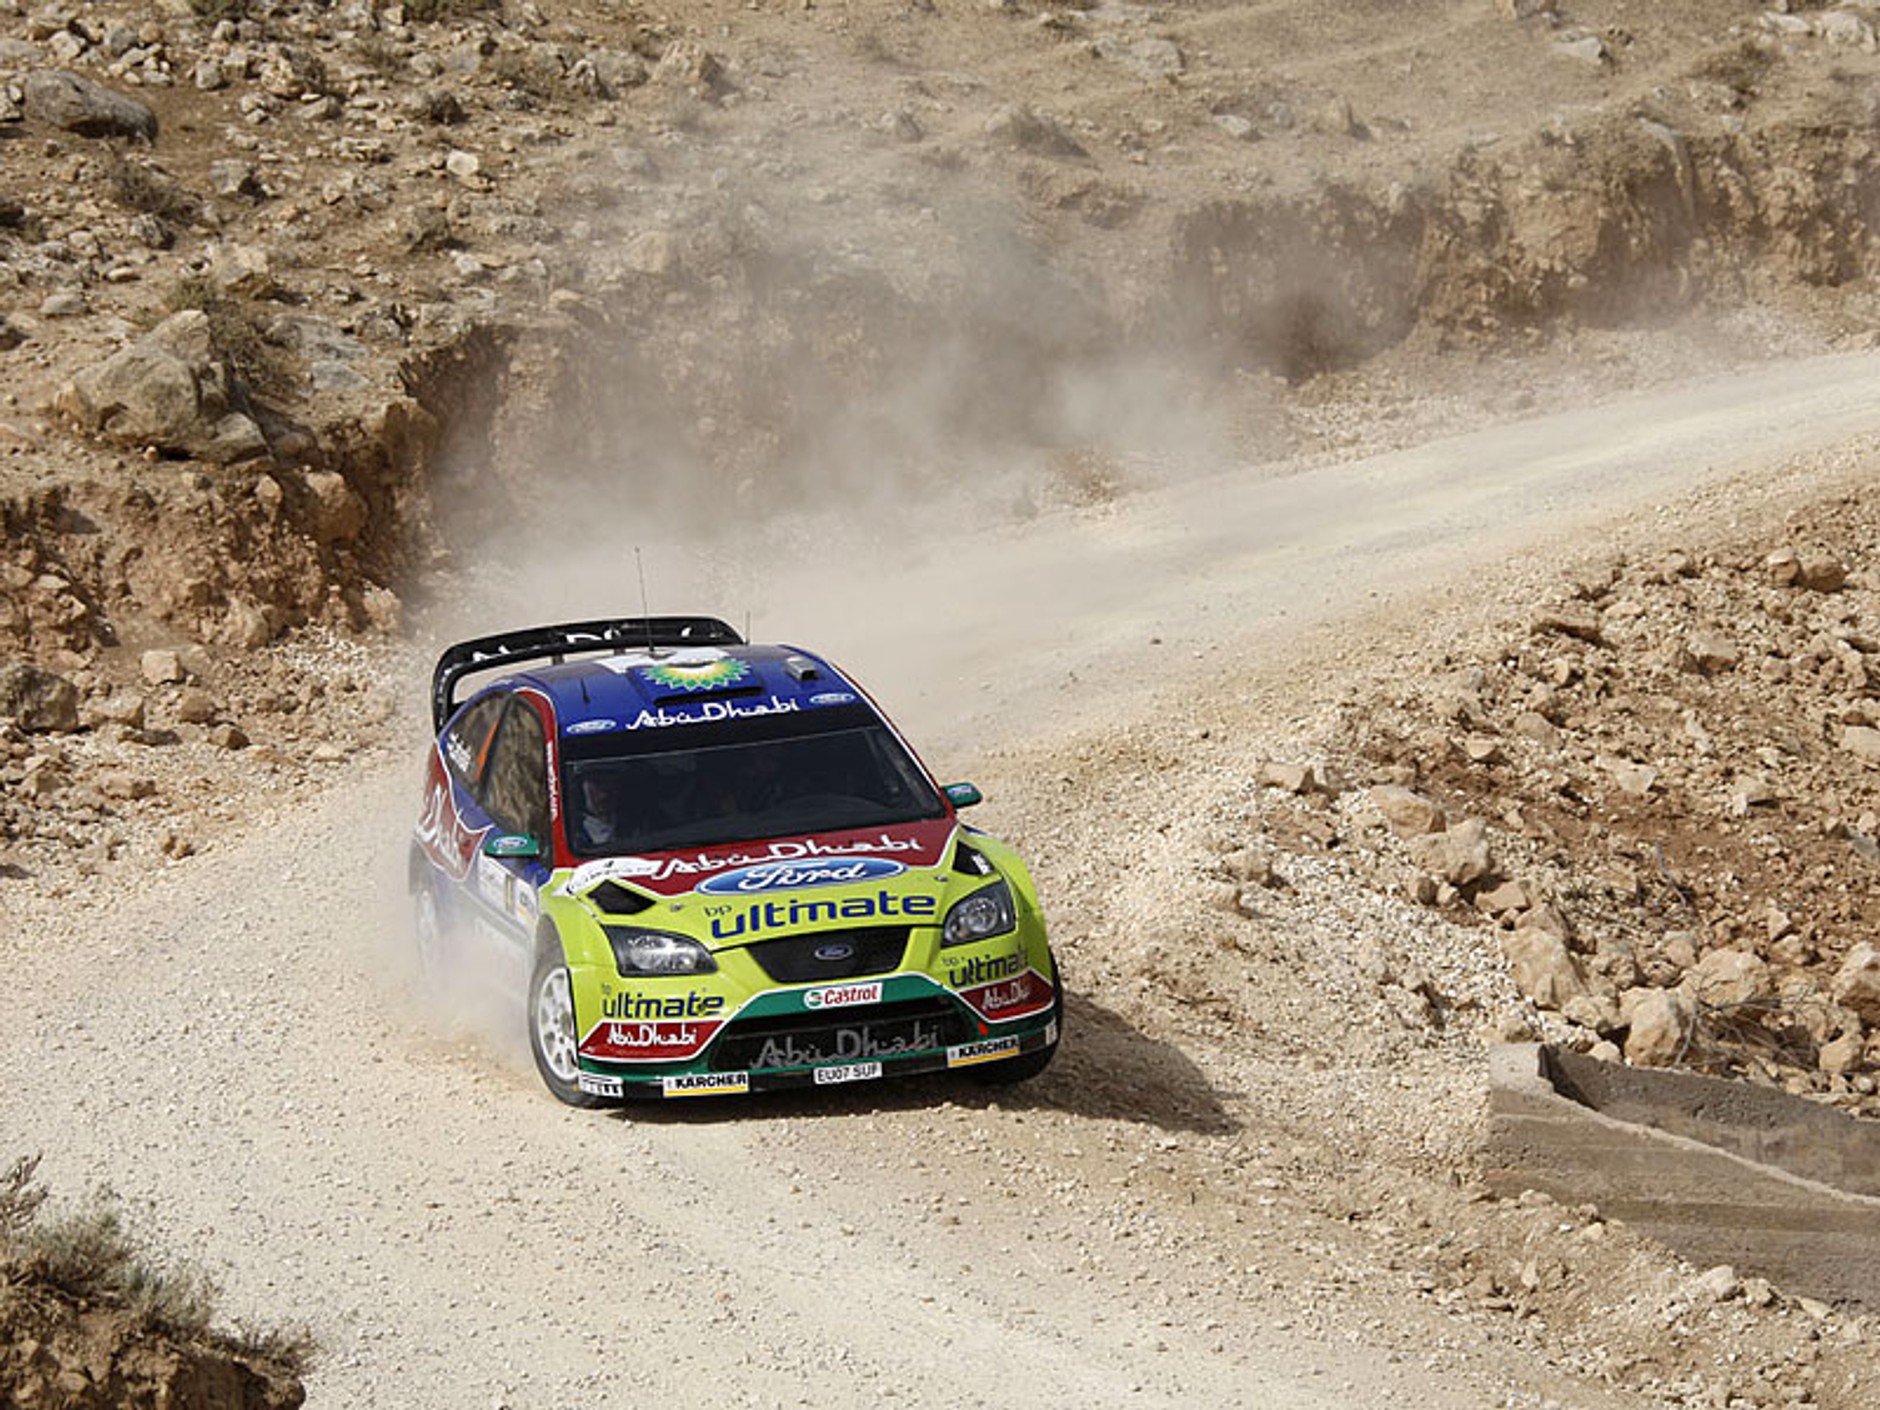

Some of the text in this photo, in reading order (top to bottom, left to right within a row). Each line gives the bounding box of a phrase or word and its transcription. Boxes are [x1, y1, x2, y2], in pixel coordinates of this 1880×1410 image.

[738, 860, 868, 891] Ford
[703, 904, 733, 918] bp
[711, 890, 937, 940] ultimate
[602, 991, 726, 1019] ultimate
[824, 984, 878, 1006] Castrol
[818, 1067, 850, 1082] EU07
